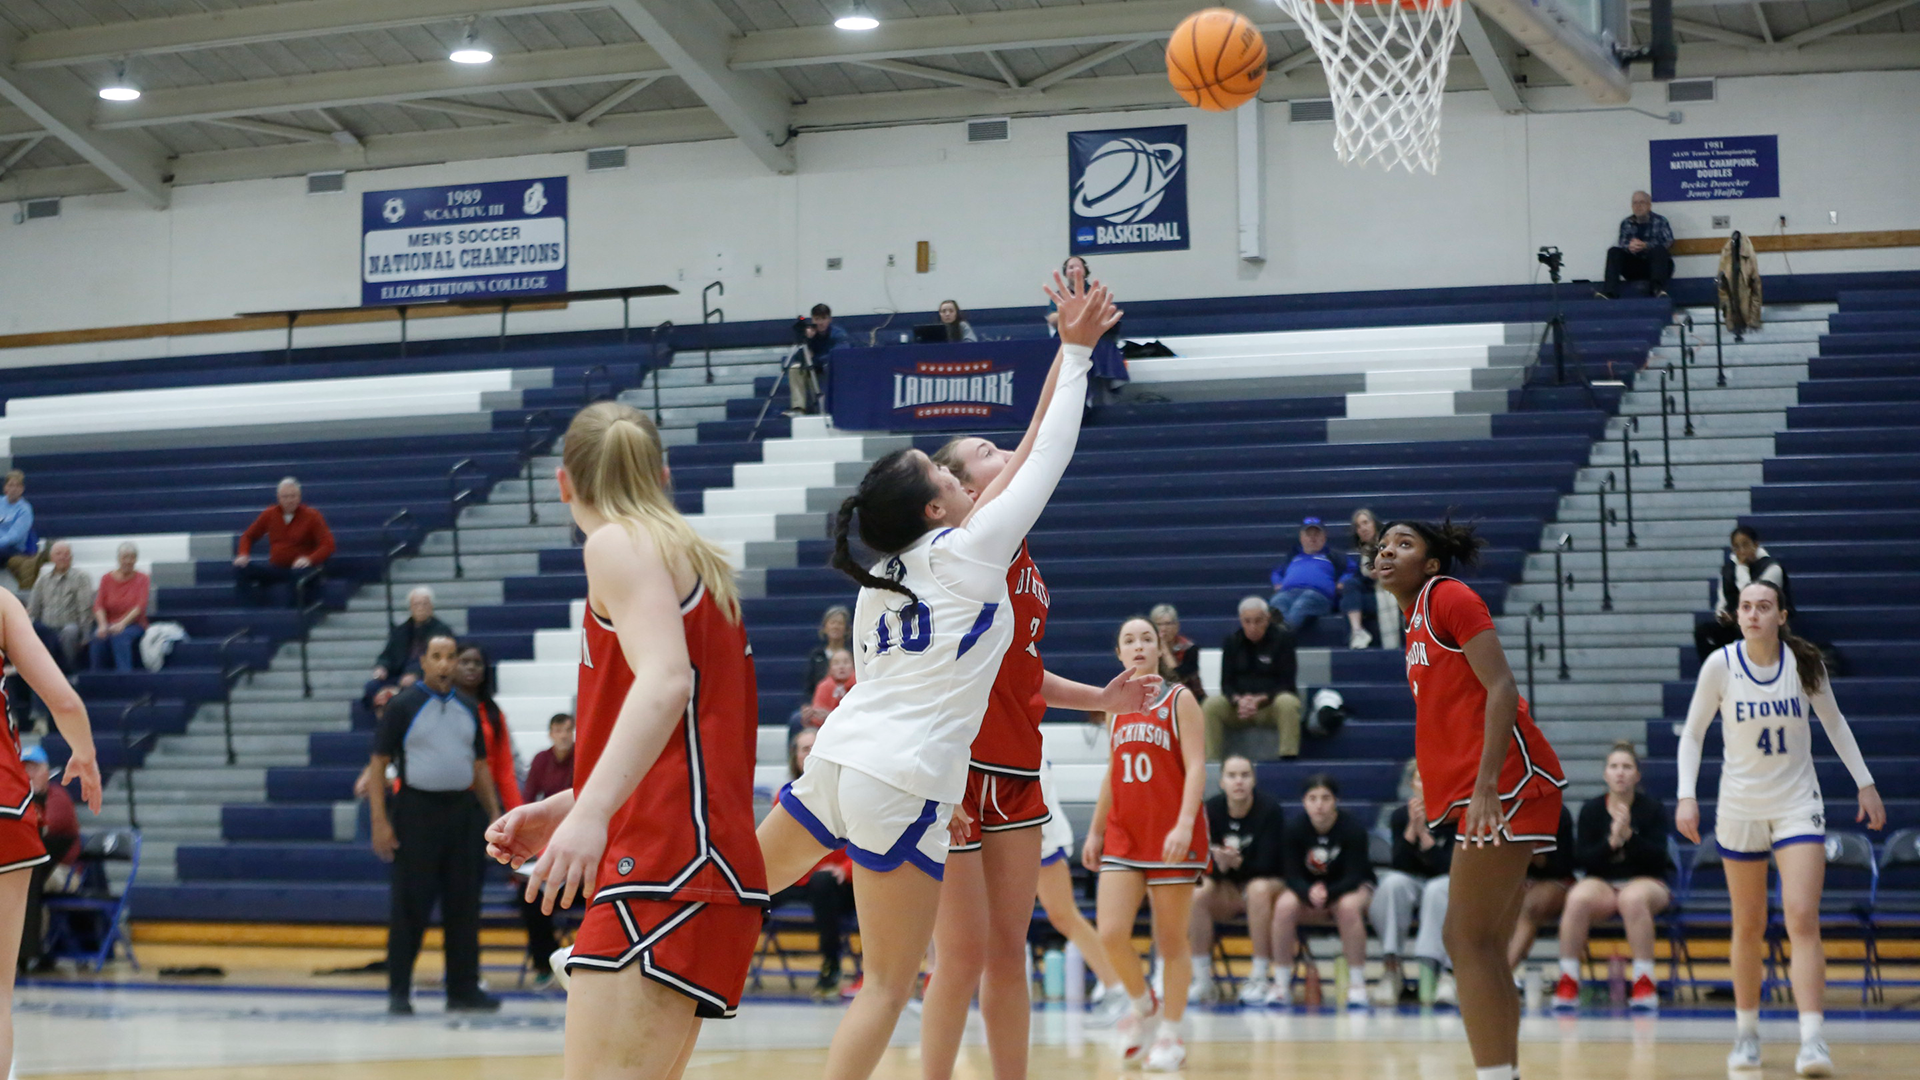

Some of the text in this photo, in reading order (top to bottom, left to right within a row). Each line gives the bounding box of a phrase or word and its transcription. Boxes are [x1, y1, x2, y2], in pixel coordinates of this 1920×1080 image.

[1703, 141, 1724, 149] 1981
[1670, 158, 1759, 170] NATIONAL CHAMPIONS,
[1697, 168, 1733, 178] DOUBLES
[446, 189, 482, 207] 1989
[1686, 189, 1711, 198] Jenny
[423, 204, 504, 221] NCAA DIV. III
[408, 226, 521, 248] MEN'S SOCCER
[1096, 222, 1181, 245] BASKETBALL
[369, 242, 561, 275] NATIONAL CHAMPIONS
[381, 276, 548, 300] ELIZABETHTOWN COLLEGE
[892, 369, 1015, 409] LANDMARK
[917, 407, 988, 417] CONFERENCE
[873, 598, 935, 656] 10
[1736, 697, 1802, 723] ETOWN
[1757, 726, 1788, 756] 41
[1121, 752, 1153, 783] 10
